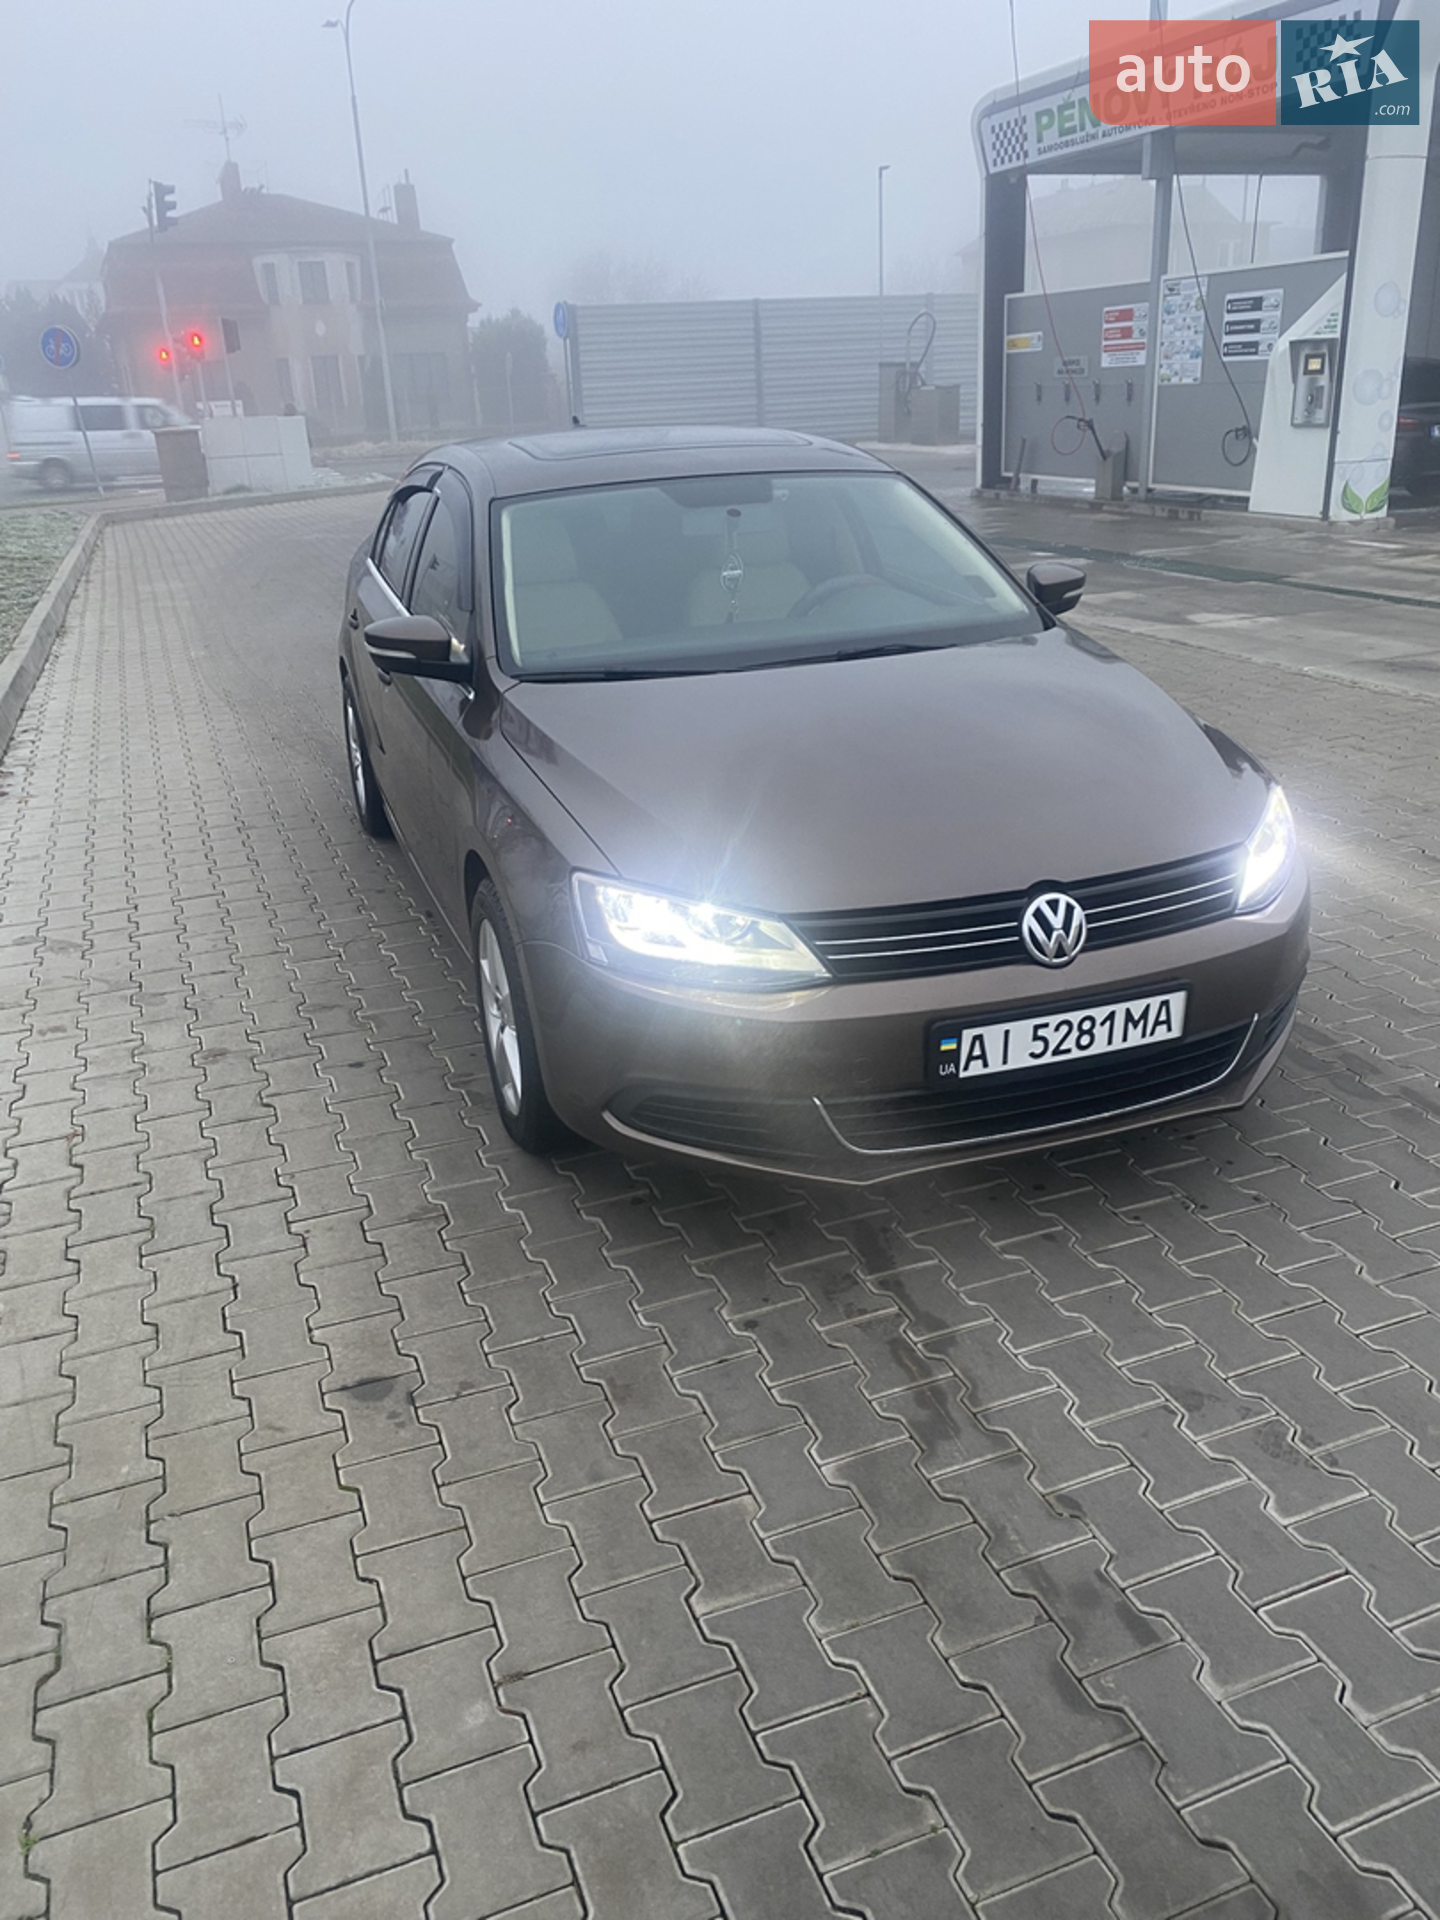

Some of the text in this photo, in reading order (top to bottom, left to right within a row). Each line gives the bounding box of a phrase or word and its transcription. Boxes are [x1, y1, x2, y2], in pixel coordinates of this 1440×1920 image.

[1037, 131, 1100, 156] SAMOOBSLUŽNÍ
[1220, 81, 1278, 107] NON-STOP
[939, 1063, 956, 1076] UA
